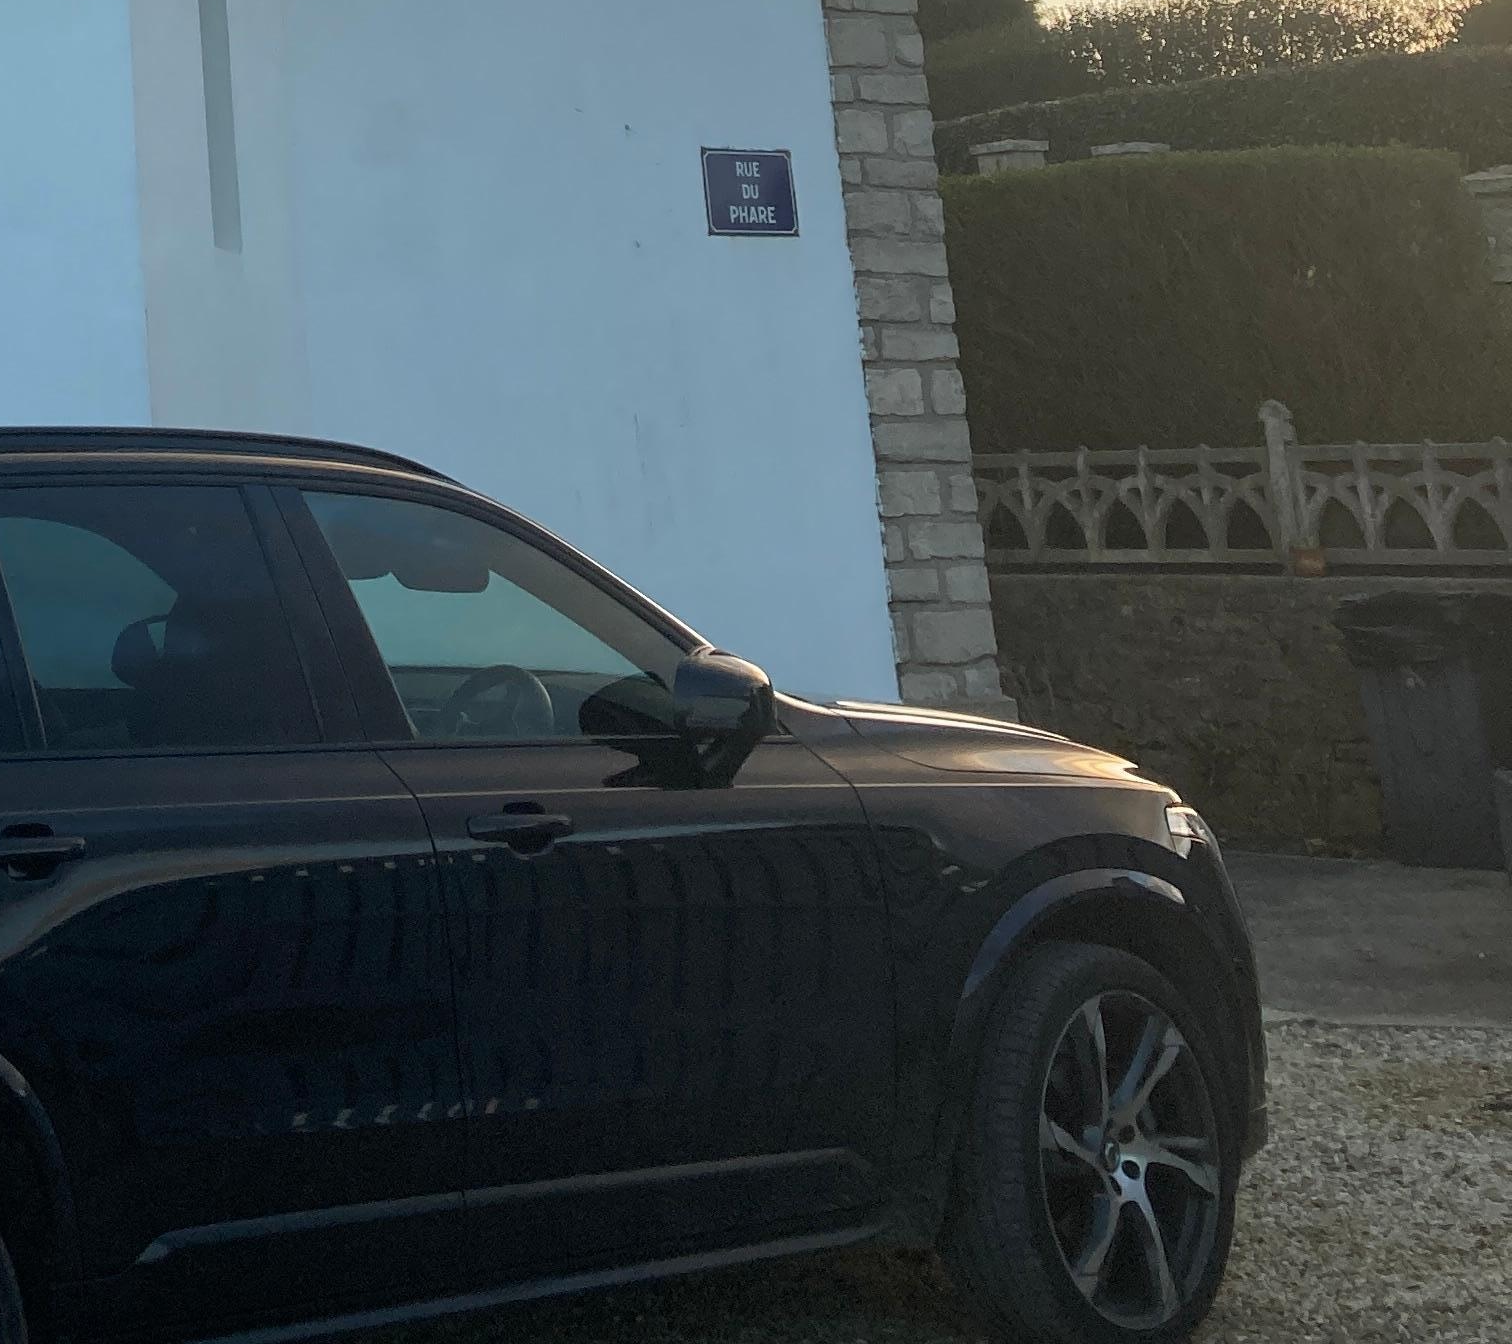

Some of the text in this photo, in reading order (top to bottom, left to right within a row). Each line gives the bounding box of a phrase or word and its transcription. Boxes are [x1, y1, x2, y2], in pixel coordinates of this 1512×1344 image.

[735, 161, 761, 178] RUE
[741, 183, 760, 200] DU
[729, 205, 777, 224] PHARE
